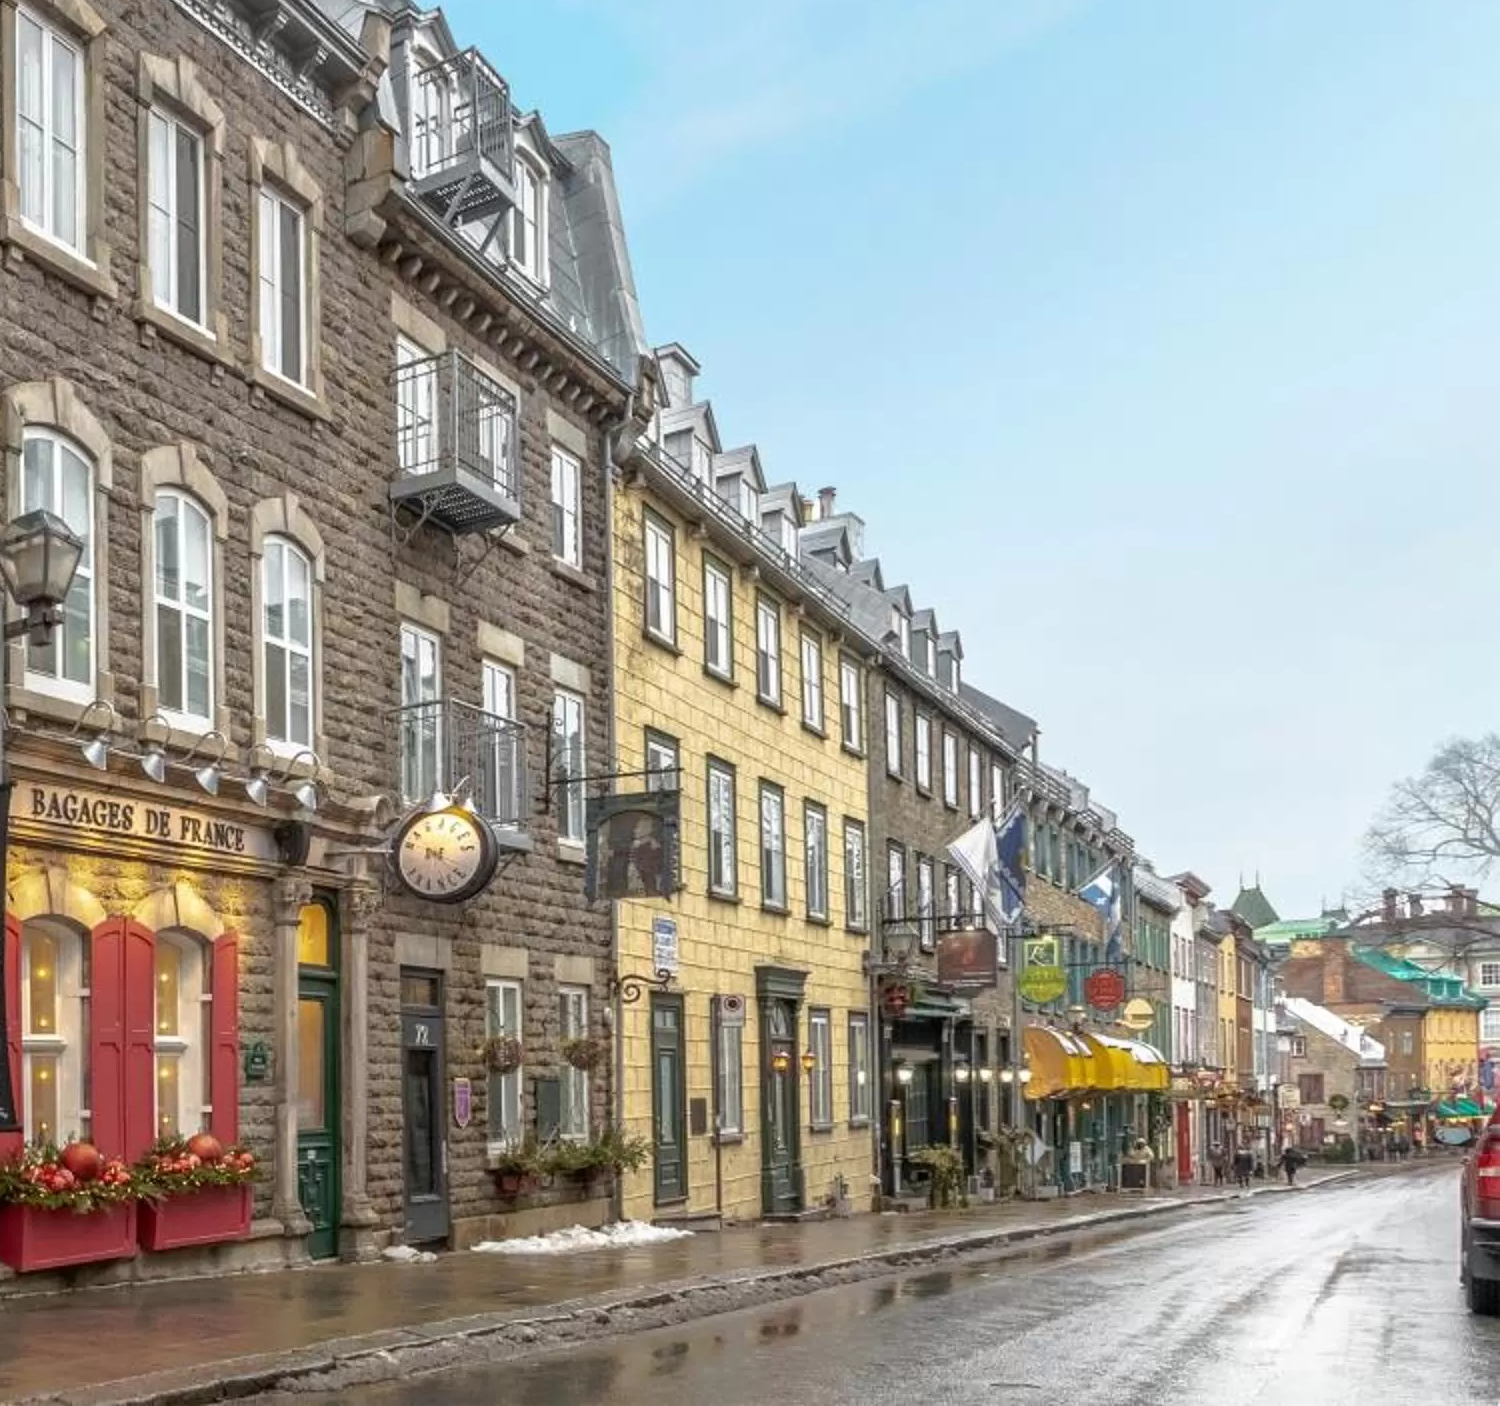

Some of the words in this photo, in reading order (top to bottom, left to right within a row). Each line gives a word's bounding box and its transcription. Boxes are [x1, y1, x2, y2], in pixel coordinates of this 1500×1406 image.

[31, 787, 134, 831] BAGAGES
[146, 808, 171, 837] DE
[180, 815, 245, 852] FRANCE
[405, 817, 475, 851] BAGAGES
